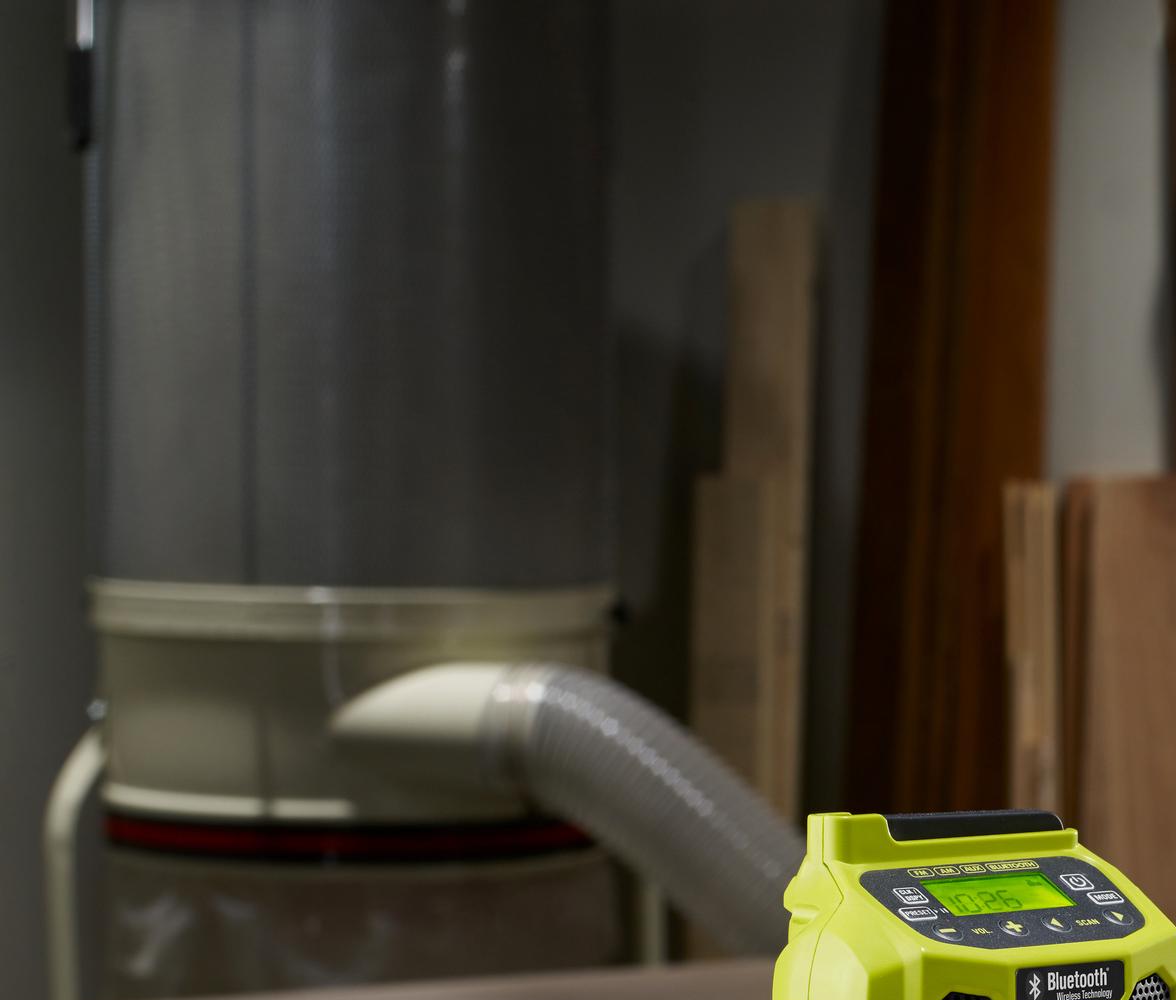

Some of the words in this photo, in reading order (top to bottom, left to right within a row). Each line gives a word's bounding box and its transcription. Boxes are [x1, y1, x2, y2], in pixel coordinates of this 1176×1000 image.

[964, 864, 983, 872] AUX
[988, 861, 1037, 871] BLUETOOTH
[914, 868, 929, 876] FM
[940, 867, 956, 875] AM
[1093, 892, 1119, 901] MODE
[904, 908, 932, 917] PRESET
[1075, 918, 1101, 926] SCAN
[1047, 967, 1108, 991] Bluetooth
[1081, 988, 1113, 999] Technology
